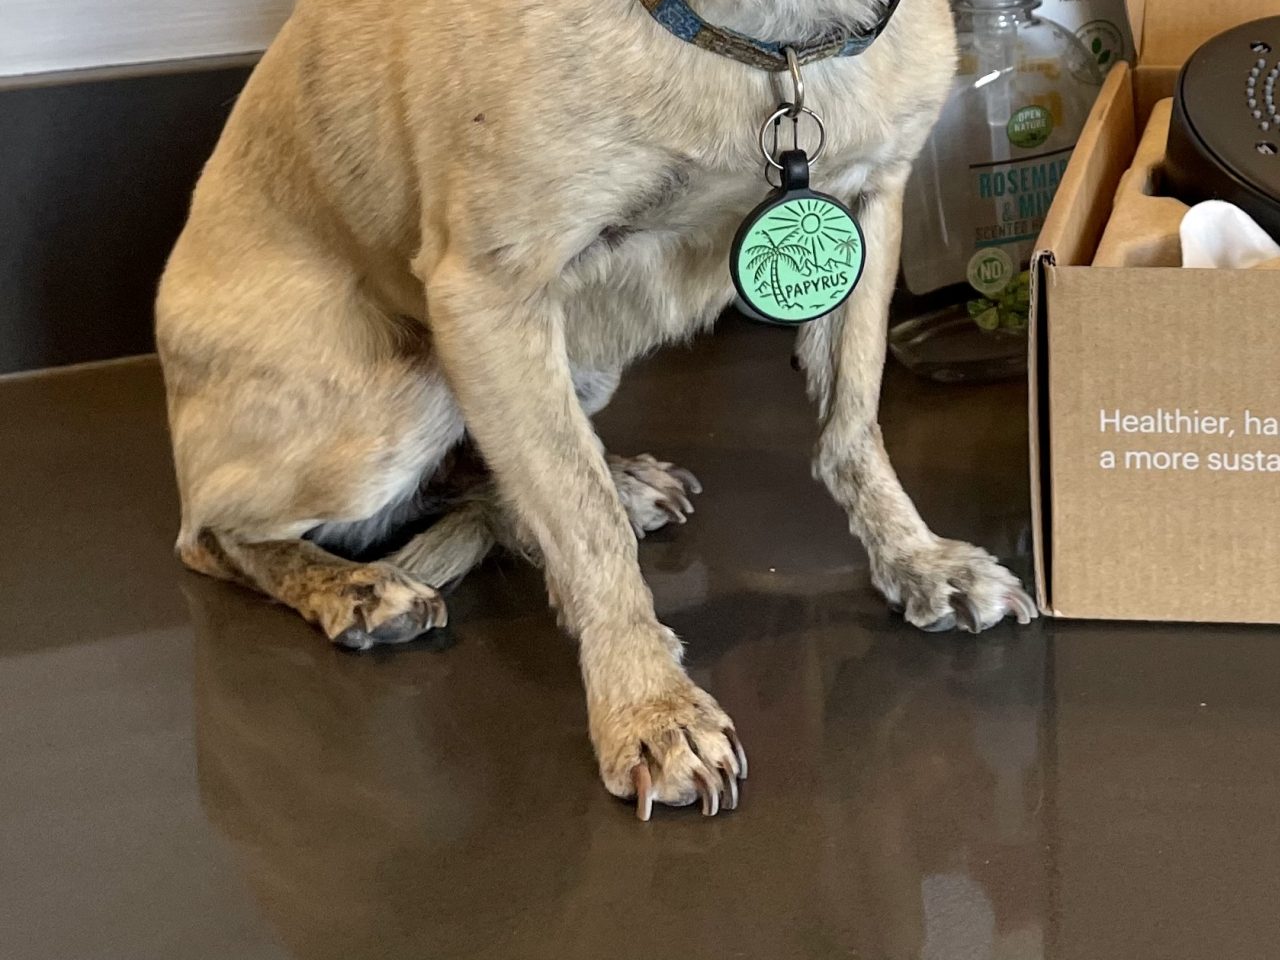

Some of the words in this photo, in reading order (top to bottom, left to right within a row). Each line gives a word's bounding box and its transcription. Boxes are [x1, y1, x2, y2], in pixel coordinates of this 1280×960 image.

[1014, 118, 1046, 132] NATURE
[1016, 109, 1041, 122] OPEN
[1002, 201, 1013, 222] &
[976, 222, 1028, 240] SCENTED
[980, 261, 1000, 280] NO
[785, 271, 848, 299] PAPYRUS
[1099, 409, 1234, 437] Healthier,
[1099, 449, 1116, 469] a
[1125, 450, 1200, 471] more
